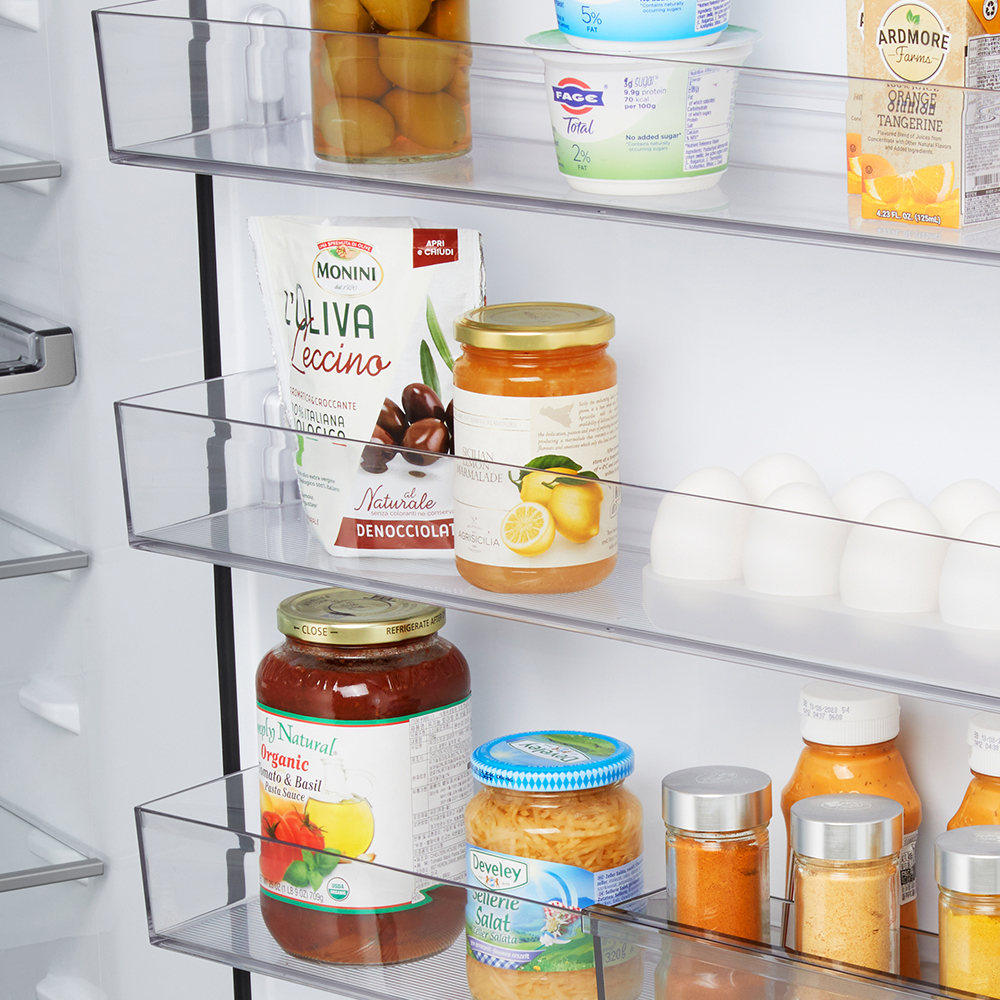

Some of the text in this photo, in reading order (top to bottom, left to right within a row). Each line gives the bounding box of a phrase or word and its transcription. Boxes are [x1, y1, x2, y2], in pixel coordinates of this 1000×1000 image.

[581, 5, 602, 25] 5%
[878, 28, 950, 50] ARDMORE
[895, 46, 933, 64] Farms
[642, 88, 667, 96] protein
[562, 117, 594, 134] Total
[877, 114, 943, 132] TANGERINE
[572, 144, 591, 163] 2%
[876, 209, 890, 219] 4.23
[914, 213, 941, 225] (125mL)
[358, 243, 371, 251] OLIVE
[424, 248, 454, 256] CHIUDI
[316, 261, 376, 281] MONINI
[284, 283, 375, 340] L'OLIVA
[291, 316, 392, 377] Leccino
[304, 408, 345, 428] ITALIANA
[354, 484, 436, 511] Naturale
[404, 487, 416, 498] al
[458, 531, 500, 546] AGRISICILIA
[301, 620, 430, 636] CLOSE REFRIGERATE
[841, 706, 850, 714] 54
[277, 721, 338, 756] Natural
[261, 743, 309, 772] Organic
[264, 781, 306, 802] Pasta Sauce
[284, 773, 292, 786] &
[295, 775, 322, 792] Basil
[472, 854, 521, 883] Develey
[309, 892, 324, 903] 709g
[475, 905, 511, 932] Salat
[490, 932, 517, 944] Salata
